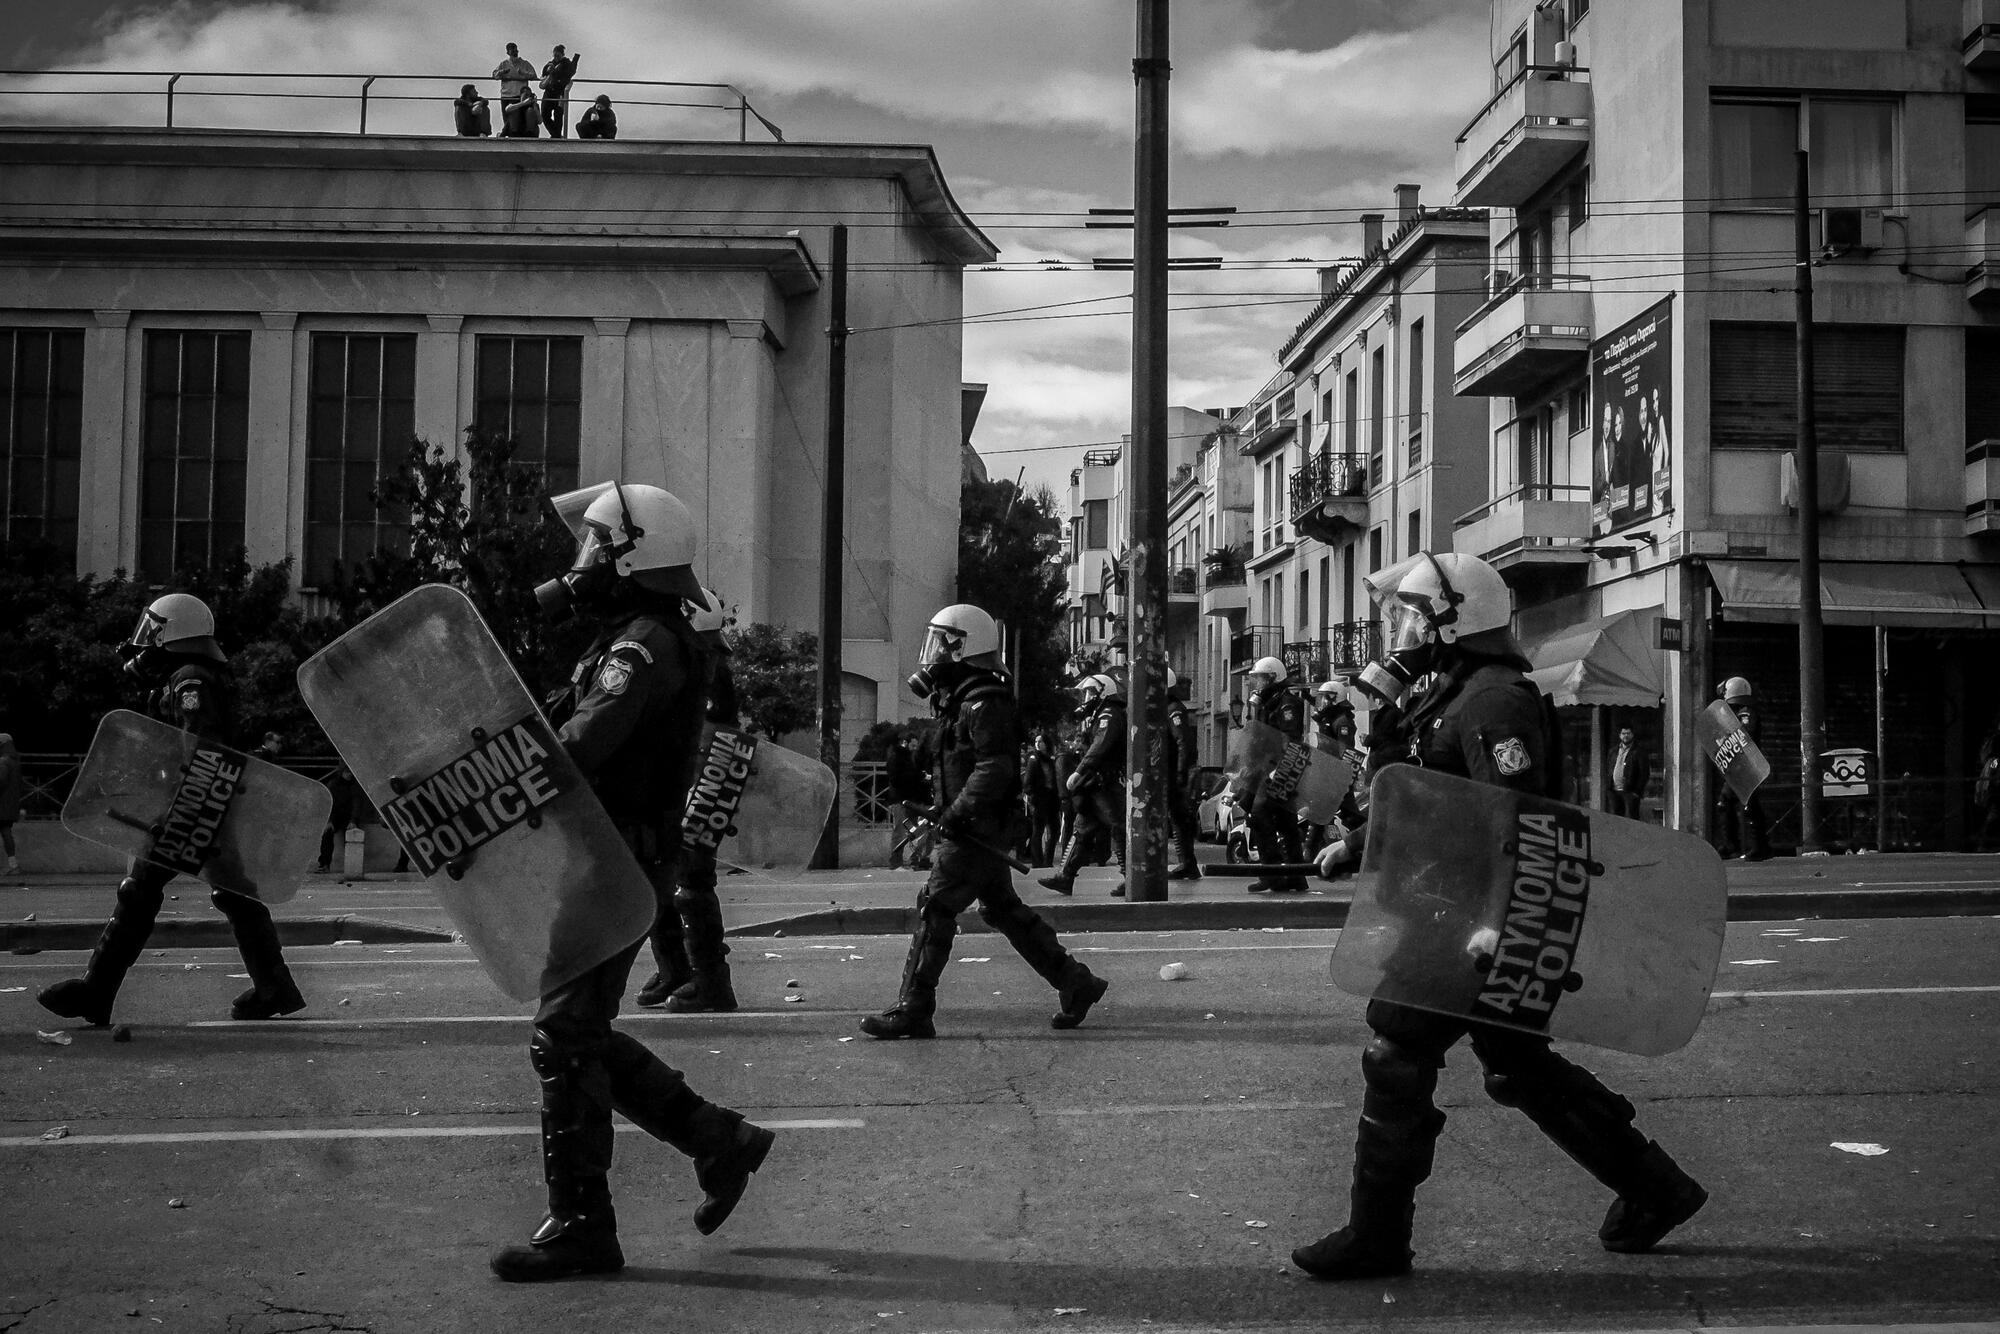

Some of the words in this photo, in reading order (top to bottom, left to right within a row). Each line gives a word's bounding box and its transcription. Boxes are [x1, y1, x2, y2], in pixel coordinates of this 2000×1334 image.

[1662, 627, 1681, 641] ATM
[154, 749, 223, 862] ΑΣΤΥΝΟΜΙΑ
[181, 760, 241, 865] POLICE
[387, 723, 549, 843] ΑΣΤΥΝΟΜΙΑ
[413, 764, 559, 871] POLICE
[699, 741, 754, 848] POLICE
[1278, 747, 1310, 801] POLICE
[1478, 813, 1556, 1015] ΑΣΤΥΝΟΜΙΑ
[1519, 827, 1588, 1012] POLICE
